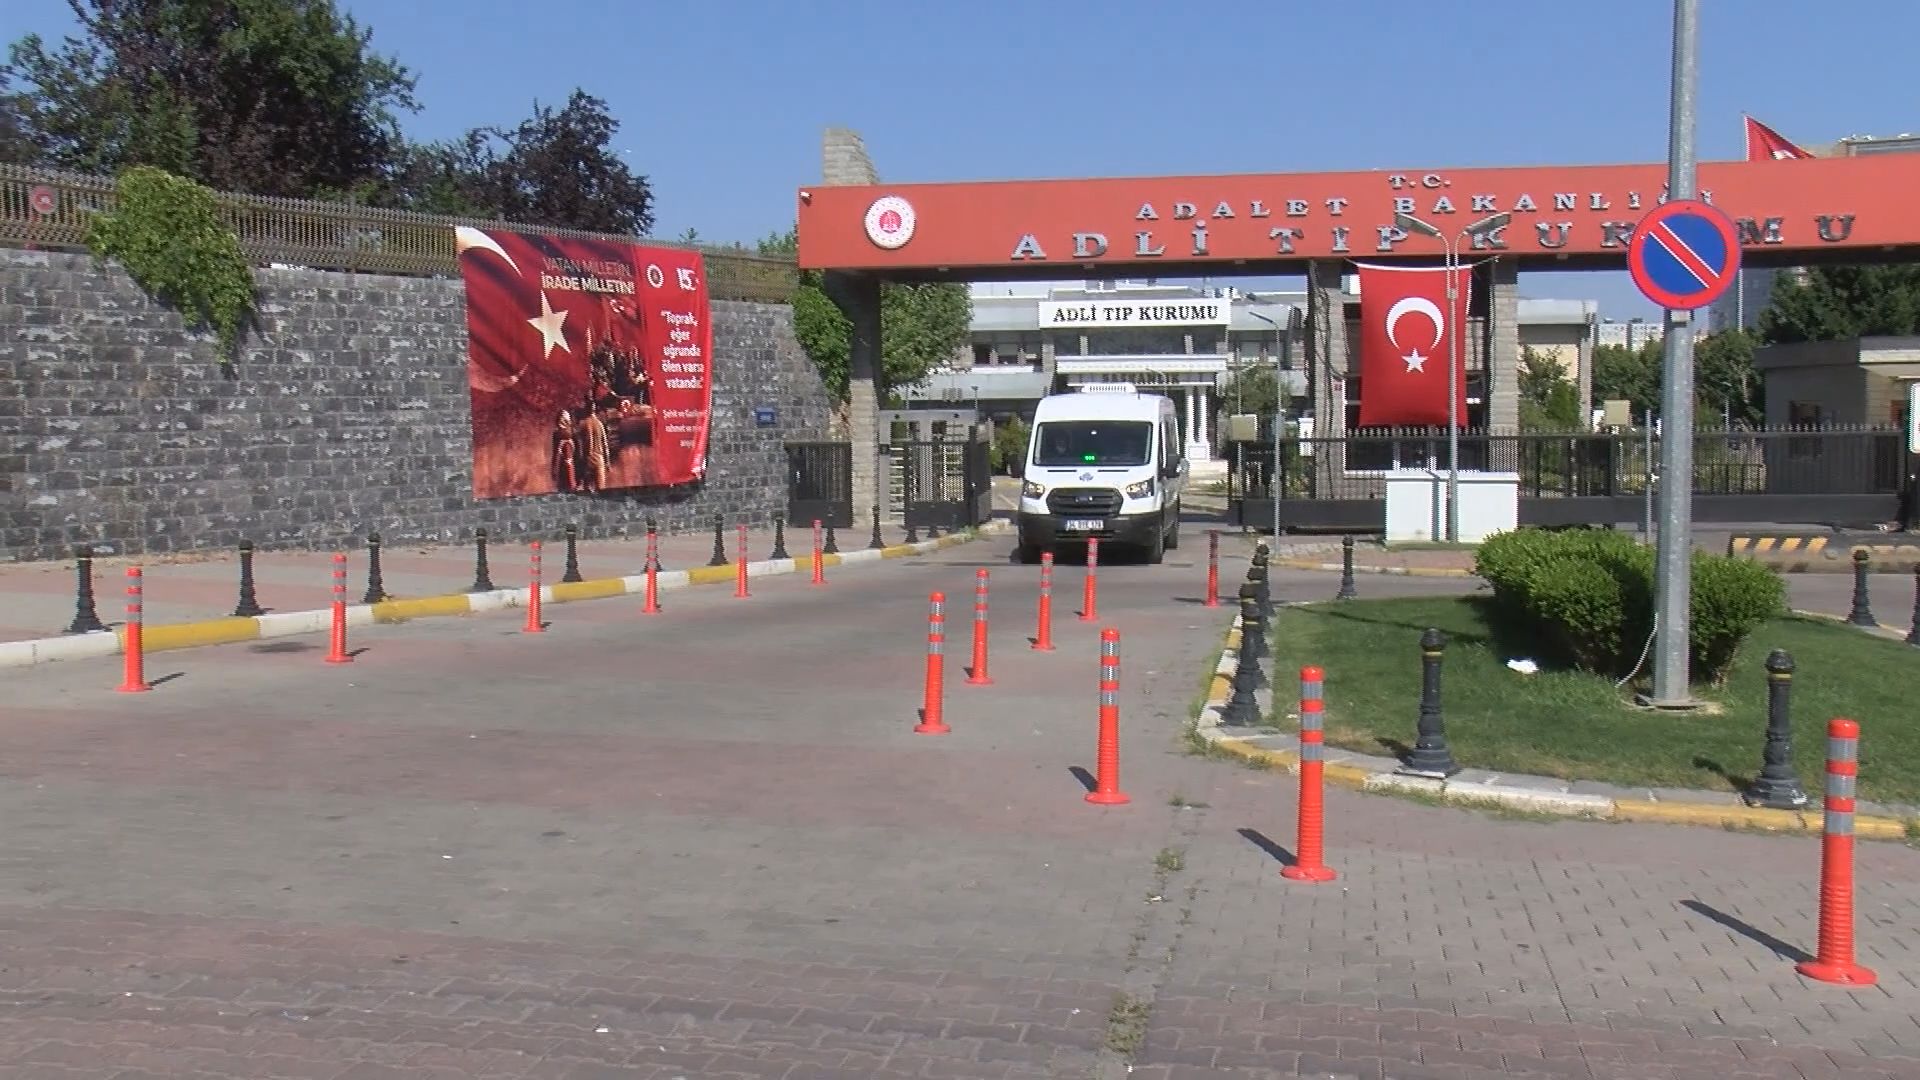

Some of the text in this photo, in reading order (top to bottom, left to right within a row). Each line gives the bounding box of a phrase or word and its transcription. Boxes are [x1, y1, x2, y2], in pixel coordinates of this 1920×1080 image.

[1389, 173, 1451, 189] T.C.
[1135, 182, 1713, 220] ADALET BAKANLII
[1010, 215, 1857, 260] ADLİ TIP KURMU
[543, 257, 633, 277] VATAN MİLLETİN
[541, 271, 636, 295] İRADE MİLLETİN!
[1053, 304, 1219, 322] ADLİ TIP KURUMU
